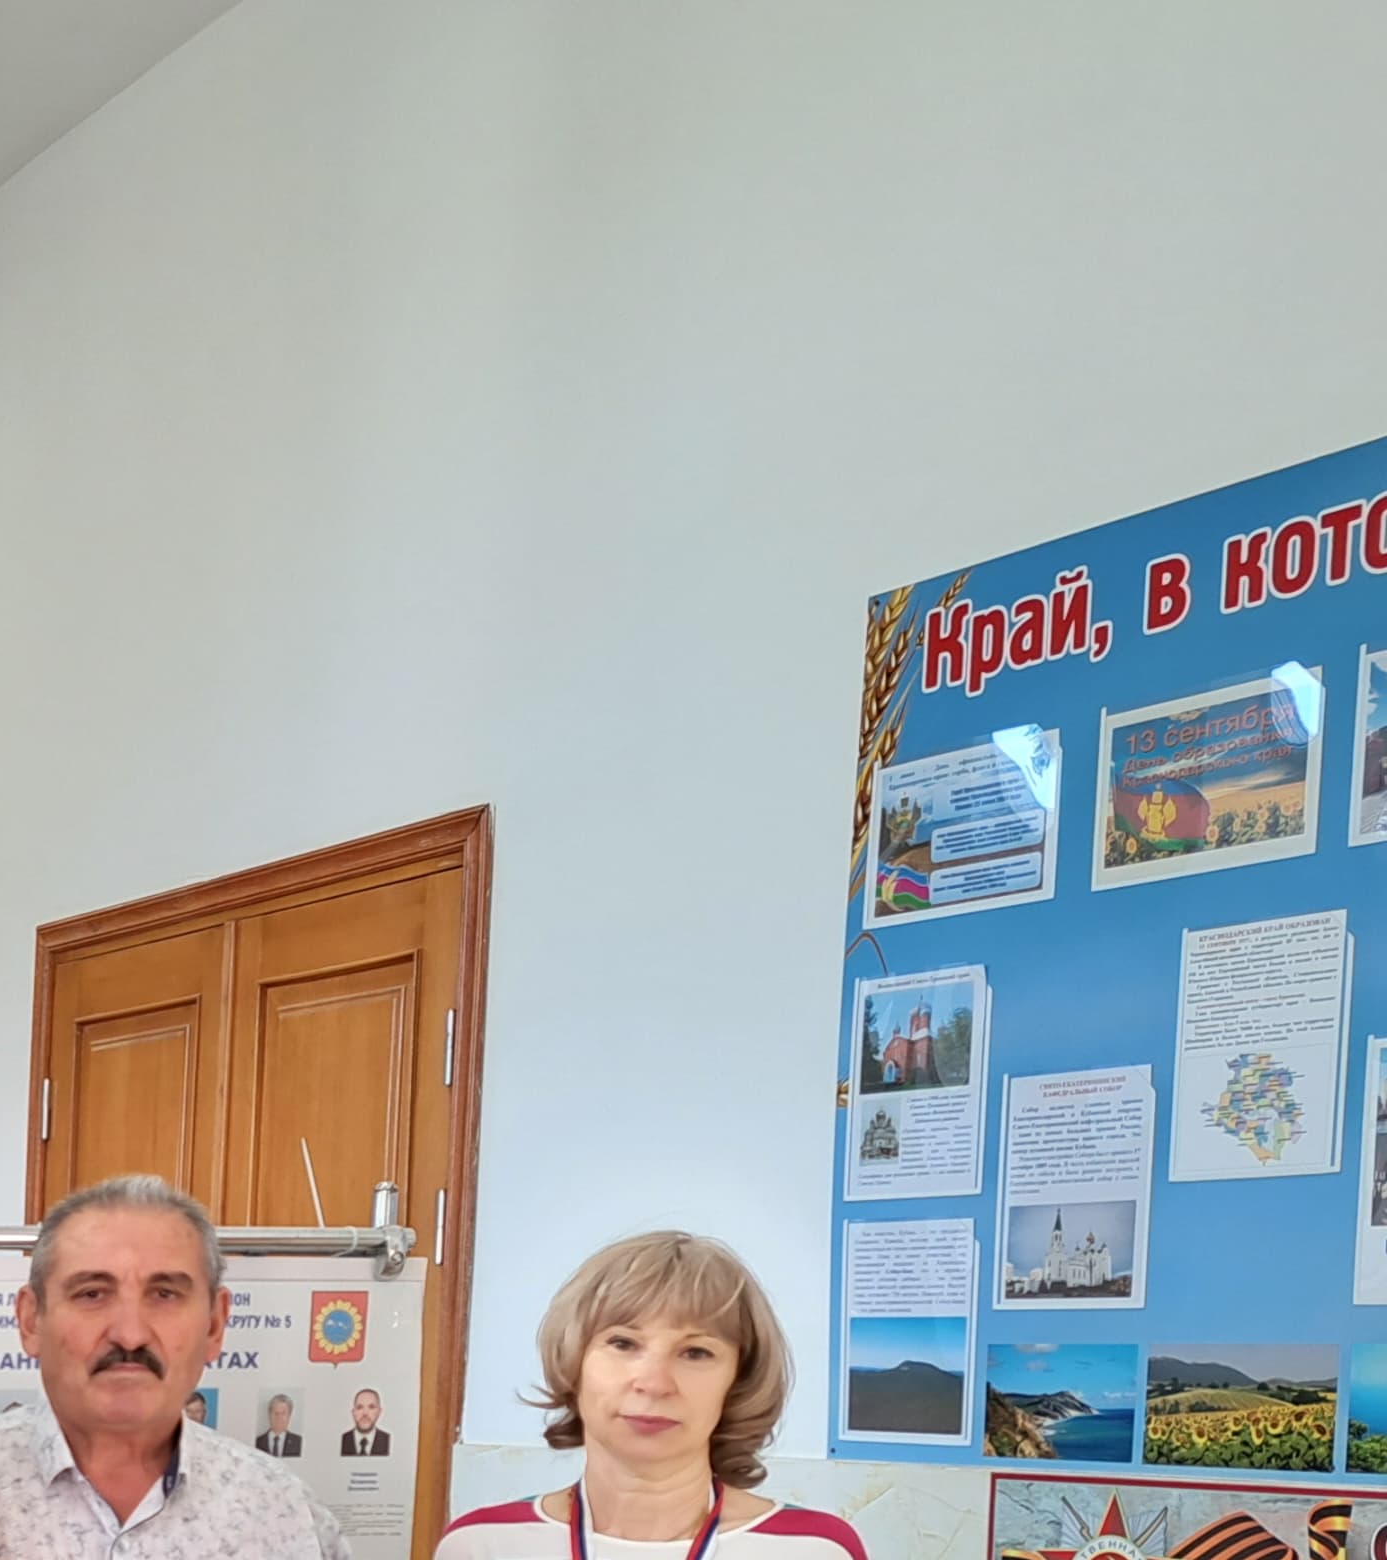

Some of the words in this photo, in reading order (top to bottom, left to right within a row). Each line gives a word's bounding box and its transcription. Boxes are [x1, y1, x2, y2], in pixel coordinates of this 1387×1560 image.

[923, 567, 1113, 695] Край,
[1220, 489, 1387, 614] кото
[1127, 728, 1157, 754] 13
[225, 1314, 263, 1329] КРУГУ
[284, 1315, 292, 1329] 5
